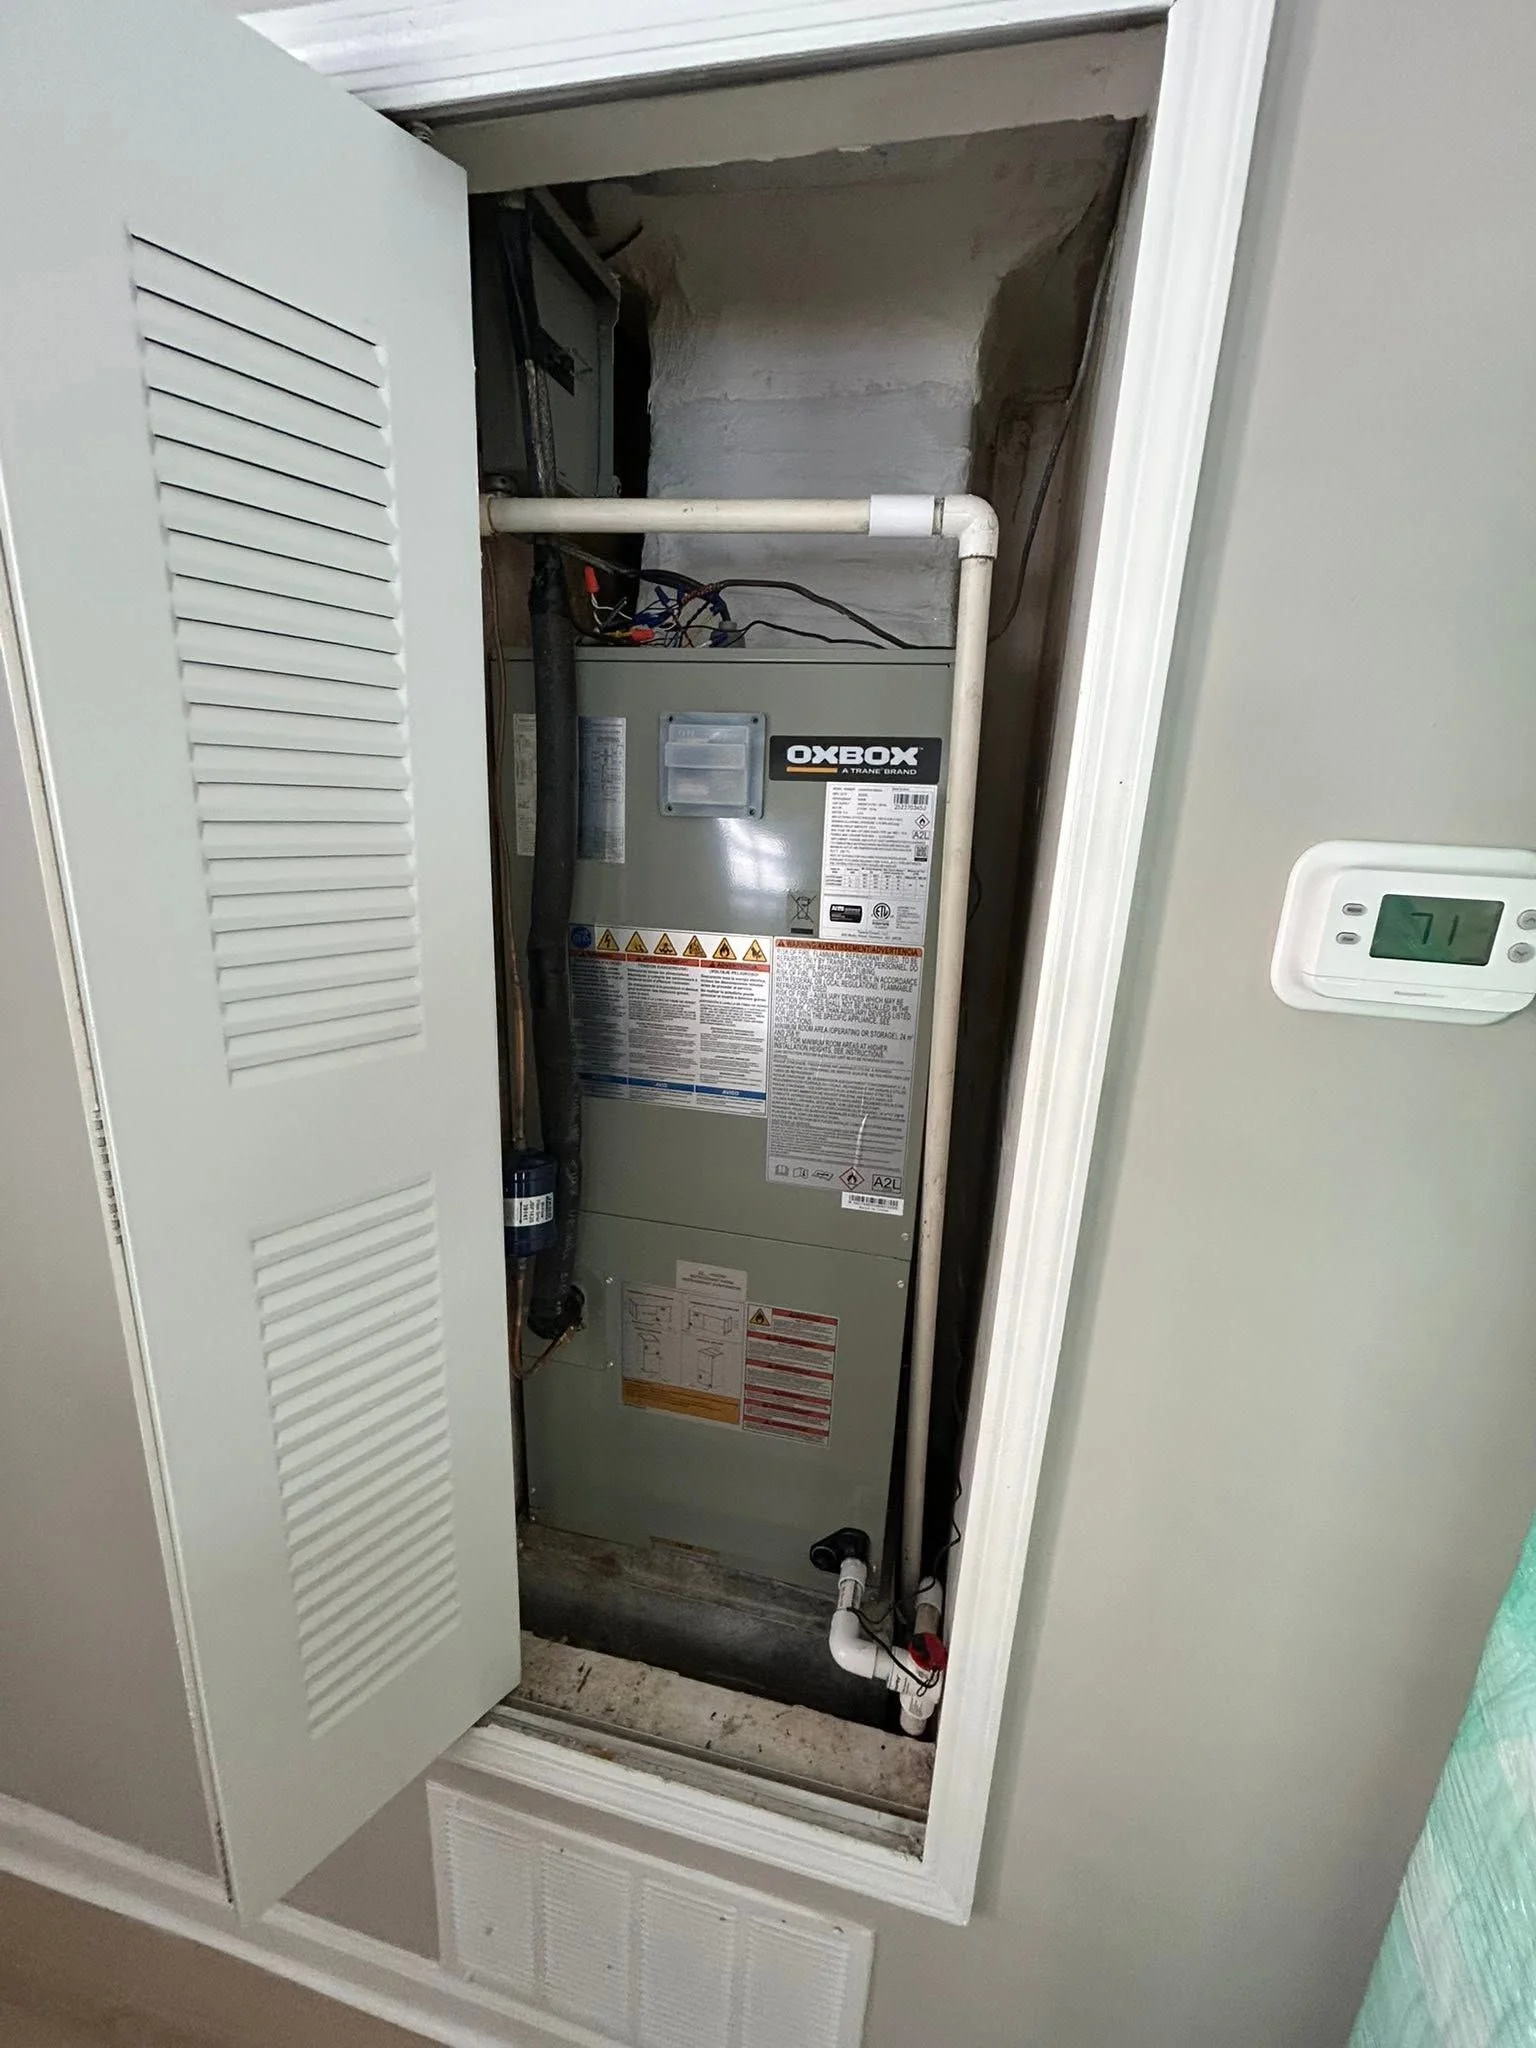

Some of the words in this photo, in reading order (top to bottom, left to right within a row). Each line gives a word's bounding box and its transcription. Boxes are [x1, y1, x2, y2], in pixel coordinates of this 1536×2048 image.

[787, 745, 918, 766] OXBOX
[912, 831, 930, 840] A2L
[1410, 911, 1458, 946] 71
[874, 1177, 901, 1190] A2L
